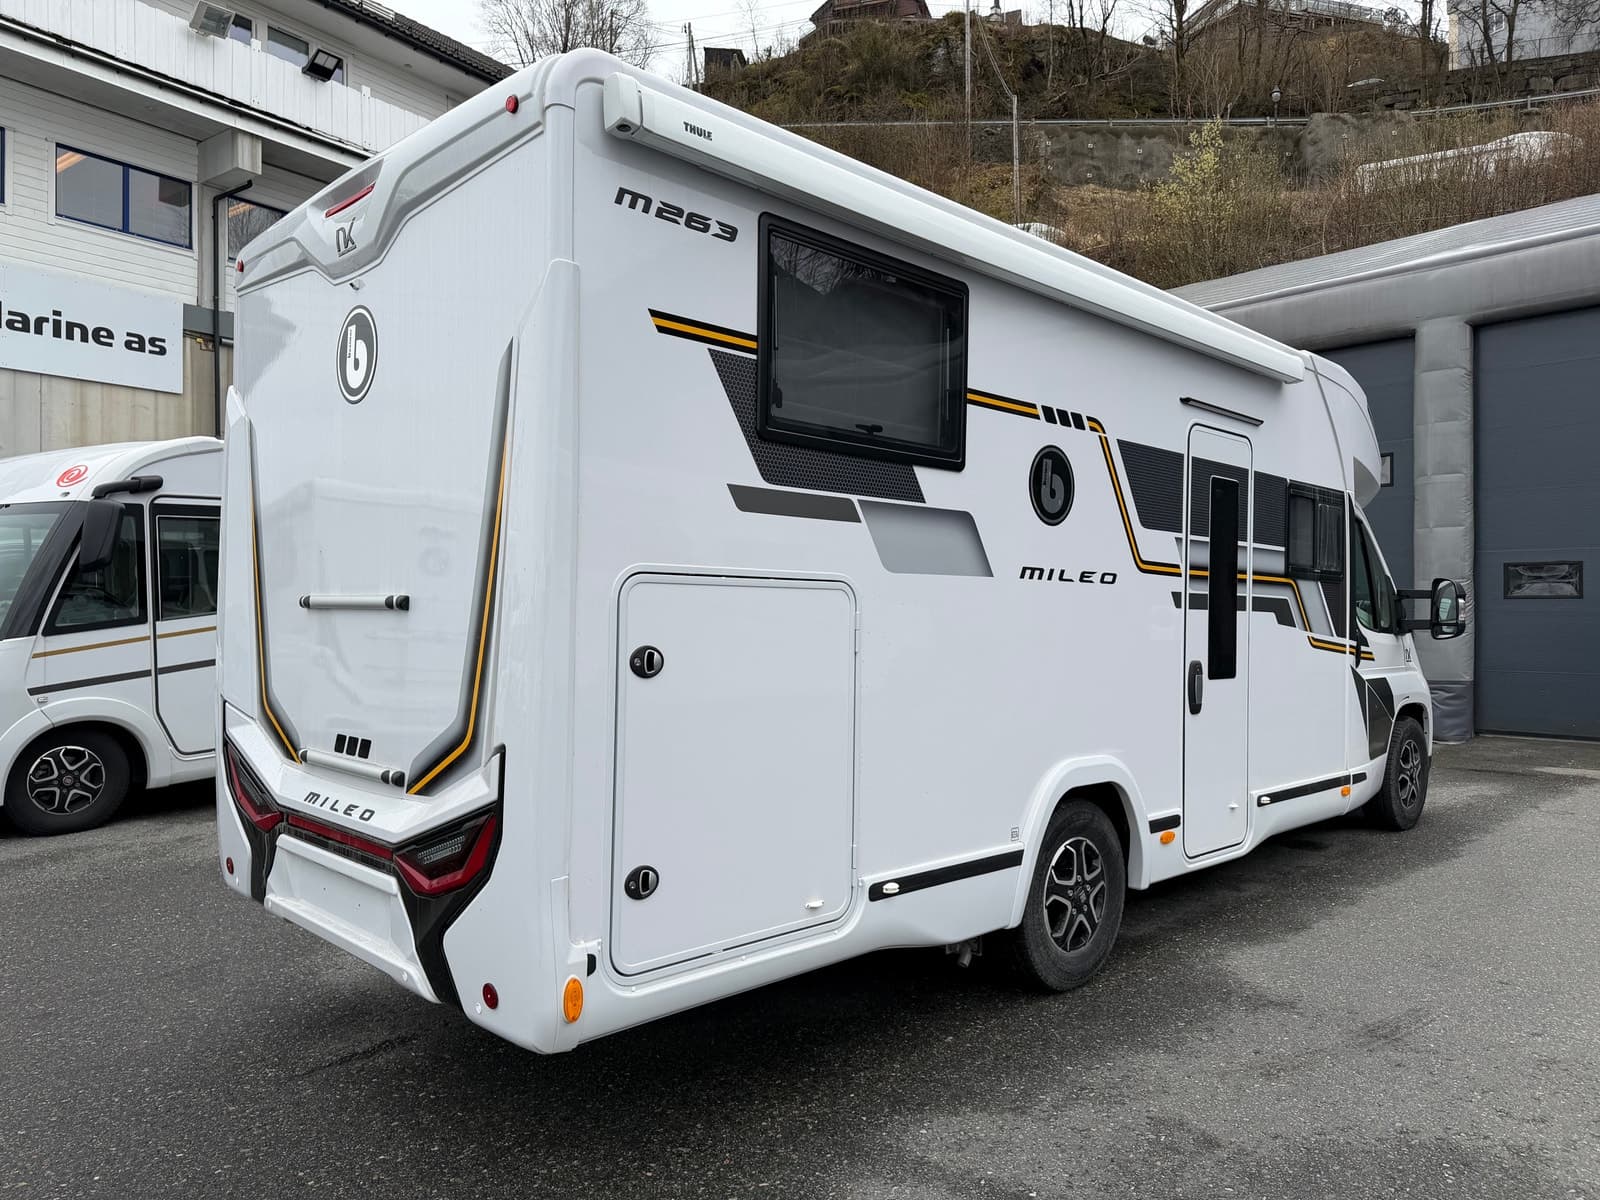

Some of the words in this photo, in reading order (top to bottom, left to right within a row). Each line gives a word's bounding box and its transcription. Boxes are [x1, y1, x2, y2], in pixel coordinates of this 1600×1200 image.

[683, 121, 713, 142] THULE
[0, 301, 115, 348] arine
[124, 331, 168, 357] as
[1019, 566, 1118, 585] MILEO
[303, 791, 376, 822] MILEO
